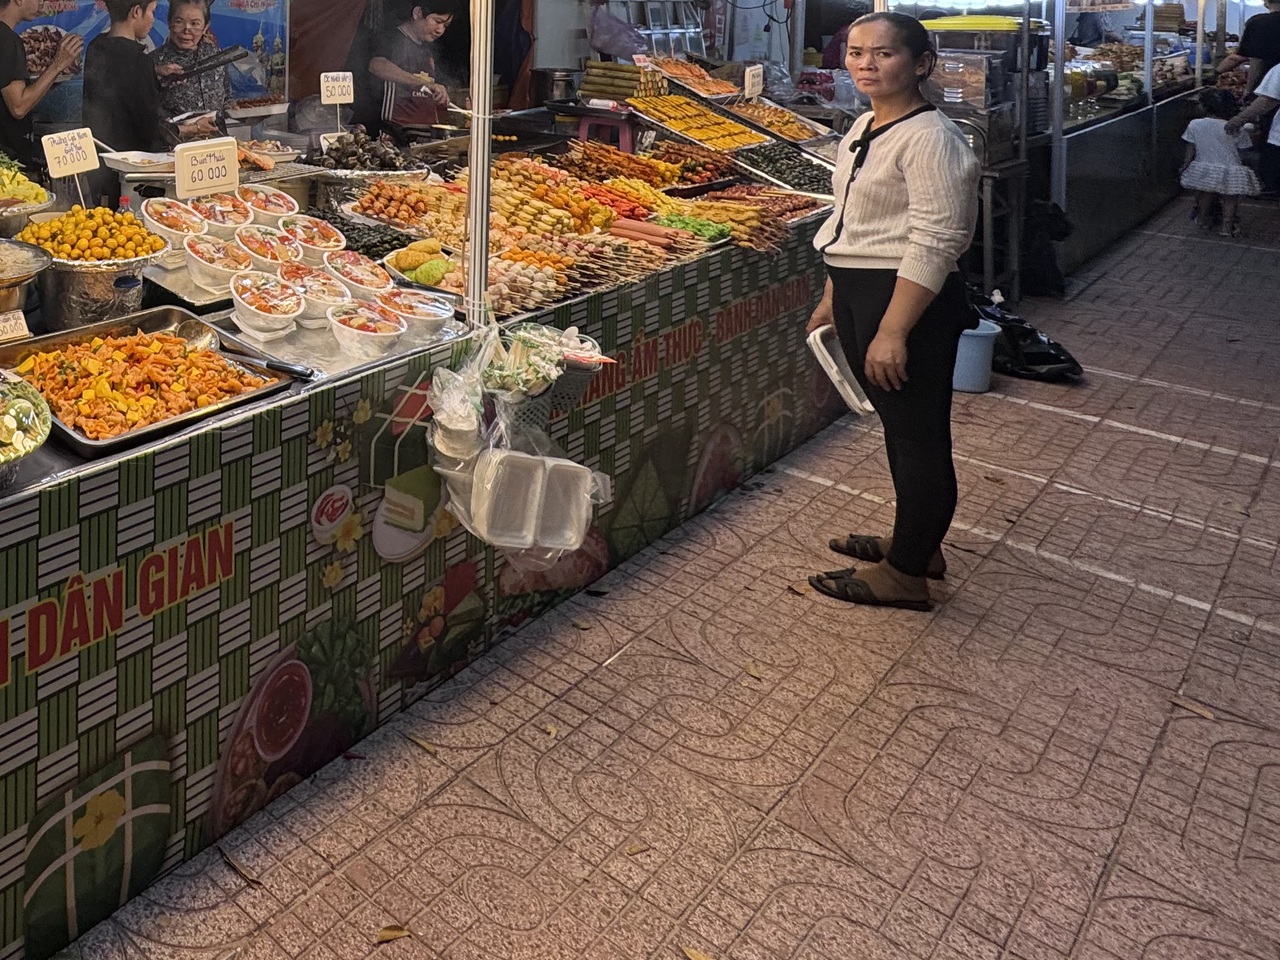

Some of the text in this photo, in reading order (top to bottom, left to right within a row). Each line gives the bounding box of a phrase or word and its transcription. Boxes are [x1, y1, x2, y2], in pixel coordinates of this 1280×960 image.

[631, 326, 658, 384] ẨM
[664, 316, 702, 368] THỰC
[25, 569, 126, 676] DÂN
[137, 517, 237, 620] GIAN
